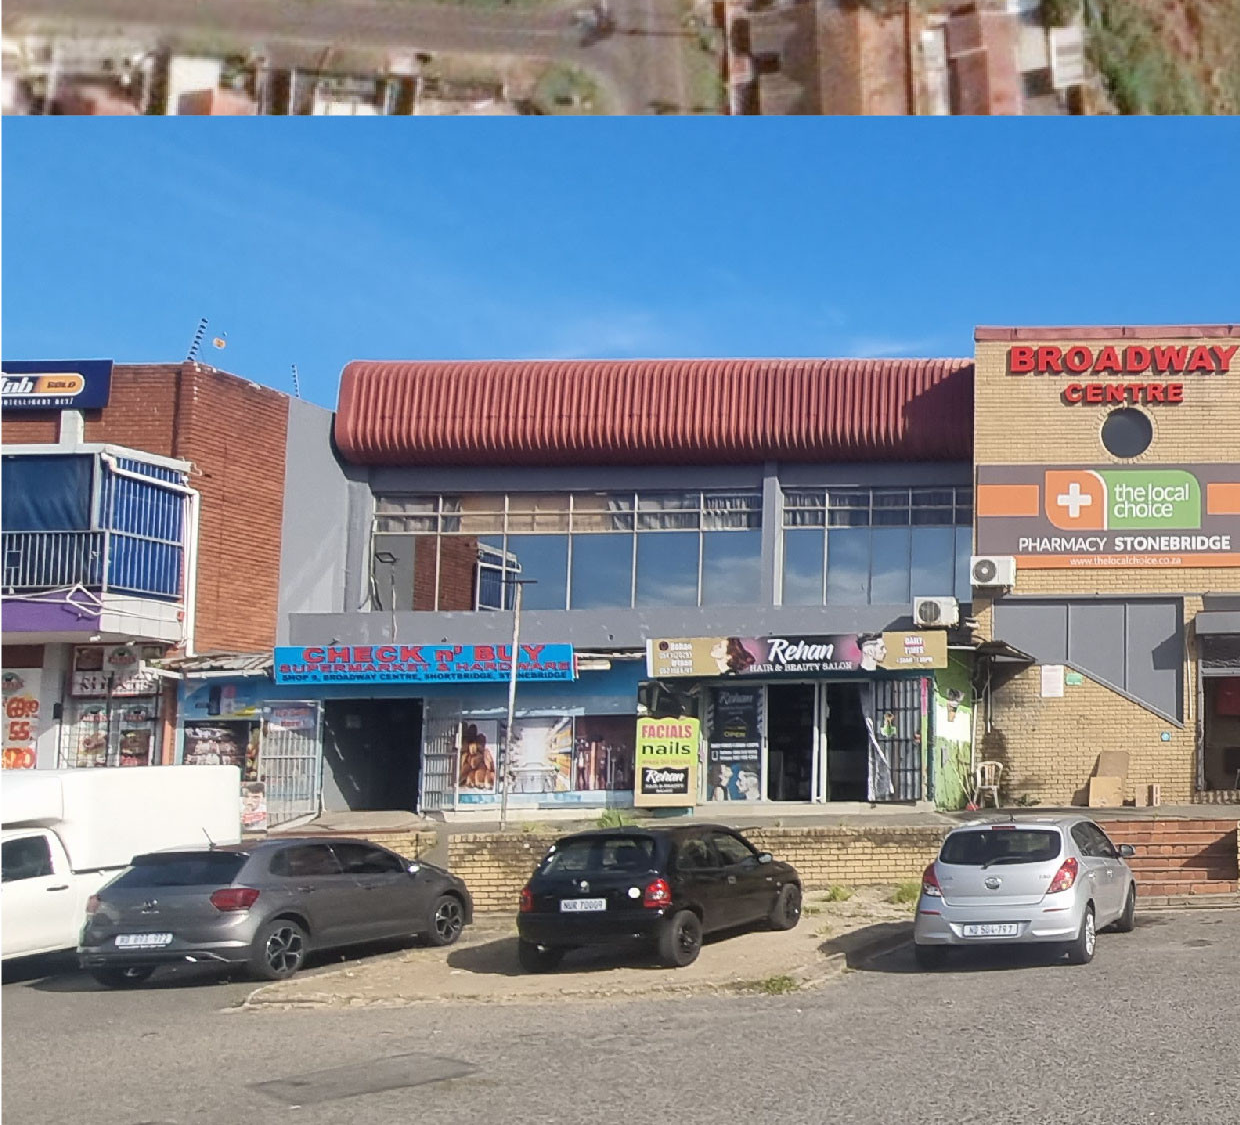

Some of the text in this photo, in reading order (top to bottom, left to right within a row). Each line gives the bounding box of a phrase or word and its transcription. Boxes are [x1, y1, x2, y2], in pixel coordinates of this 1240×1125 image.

[1009, 345, 1240, 373] BROADWAY
[1063, 383, 1184, 403] CENTRE
[1114, 483, 1190, 502] the local
[1113, 501, 1174, 518] choice
[1018, 535, 1231, 552] PHARMACY STONEBRIDGE
[1069, 555, 1182, 566] www.thelocalchoice.co.za
[302, 646, 427, 664] CHECK
[474, 645, 546, 661] BUY
[767, 638, 834, 664] Rehan
[280, 663, 430, 673] SUPERMARKET
[455, 661, 570, 672] HARDWARE
[750, 661, 853, 672] HAIR & BEAUTY SALON
[282, 674, 309, 682] SHOP
[322, 674, 377, 682] BROADWAY
[499, 672, 567, 680] STNEBRIDGE
[641, 725, 692, 739] FACIALS
[641, 741, 691, 755] nails
[645, 769, 685, 784] Rehan
